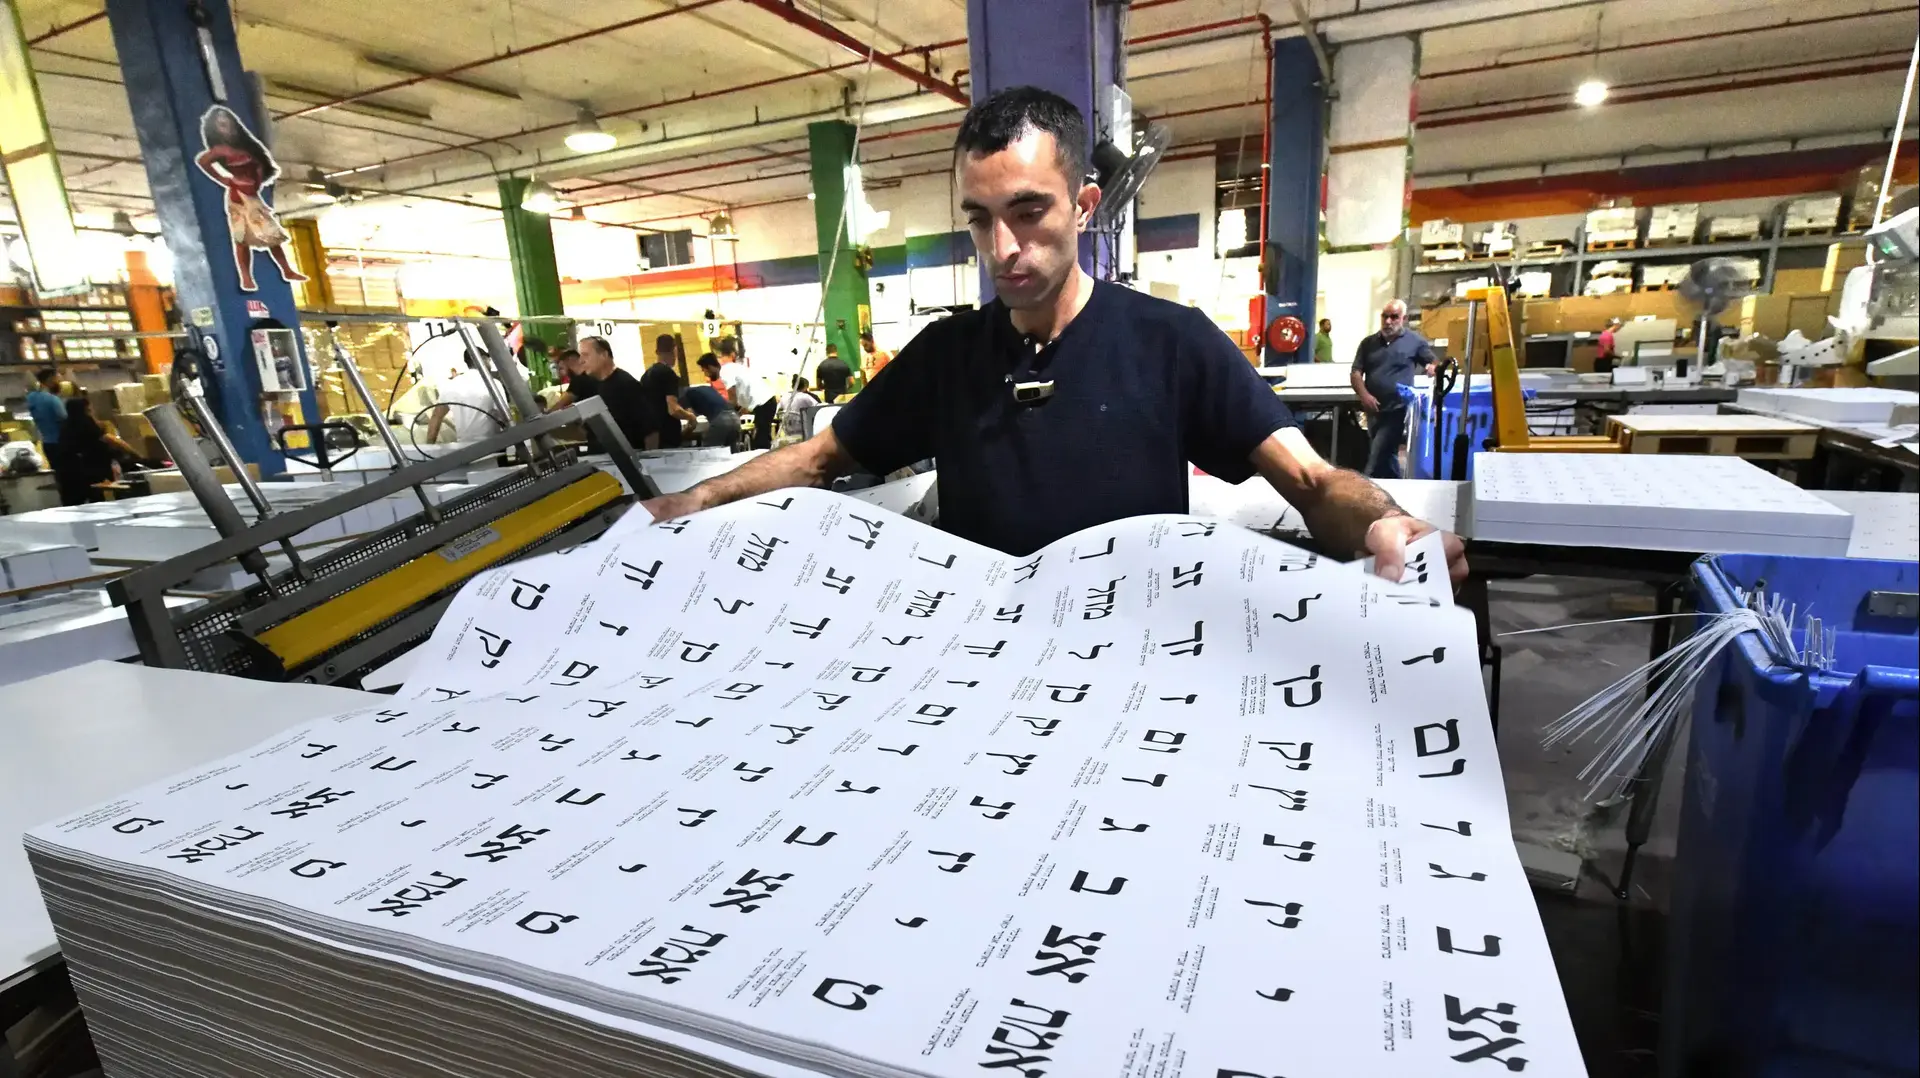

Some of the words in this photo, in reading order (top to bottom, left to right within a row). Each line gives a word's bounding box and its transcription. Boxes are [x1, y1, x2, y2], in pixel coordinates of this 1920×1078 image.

[425, 322, 445, 338] 11
[596, 322, 613, 336] 10
[708, 323, 714, 335] 9
[737, 533, 789, 572] מחל
[1172, 561, 1204, 588] זנ
[511, 578, 550, 610] כן
[905, 590, 955, 617] מחל
[1083, 575, 1126, 620] מחל
[714, 598, 754, 614] ל
[1273, 593, 1322, 622] ל
[600, 621, 629, 636] ז
[475, 627, 512, 668] יק
[680, 641, 720, 662] כן
[882, 636, 923, 646] ל
[1068, 642, 1113, 659] ל
[1373, 644, 1383, 665] חברתי
[1402, 647, 1446, 665] ז
[550, 661, 599, 686] ום
[1376, 665, 1384, 678] כוח
[714, 683, 764, 700] ום
[1272, 665, 1322, 707] כן
[1368, 677, 1378, 704] בראשות
[1379, 679, 1388, 695] שחר
[813, 692, 851, 710] יק
[1160, 694, 1198, 704] ז
[908, 704, 958, 725] ום
[1016, 716, 1061, 736] יק
[442, 722, 480, 733] ג
[1139, 730, 1187, 753] ום
[1414, 719, 1466, 778] ום
[370, 756, 417, 771] ב
[620, 750, 661, 760] ג
[1258, 741, 1313, 771] יק
[733, 762, 773, 782] ינ
[555, 788, 606, 805] ב
[835, 780, 881, 794] ג
[1248, 784, 1308, 811] יץ
[270, 787, 355, 819] אצ
[970, 795, 1016, 819] ינ
[112, 817, 164, 834] ט
[783, 825, 838, 846] ב
[1099, 817, 1150, 832] ג
[167, 825, 264, 863] אמת
[464, 824, 551, 862] אצ
[1263, 834, 1316, 862] ינ
[289, 859, 347, 878] ט
[619, 864, 647, 873] י
[1429, 863, 1488, 881] ג
[367, 871, 469, 917] אמת
[709, 868, 794, 913] אצ
[1070, 870, 1128, 895] ב
[515, 910, 580, 935] ט
[895, 917, 928, 928] י
[1381, 935, 1392, 959] בראשות
[1436, 926, 1501, 957] ב
[628, 925, 728, 984] אמת
[976, 944, 996, 968] בראשות
[1026, 925, 1106, 983] אצ
[812, 978, 883, 1011] ט
[1166, 978, 1181, 1002] בראשות
[1256, 988, 1295, 1002] י
[1180, 994, 1194, 1014] ישראל
[921, 1026, 946, 1056] בראשות
[940, 1010, 956, 1025] מרב
[943, 1025, 964, 1048] מפלגת
[958, 998, 979, 1024] העבודה
[1401, 1020, 1413, 1040] חופש
[1444, 994, 1529, 1072] אצ
[978, 998, 1072, 1078] אמת
[1383, 1021, 1395, 1052] בראשות
